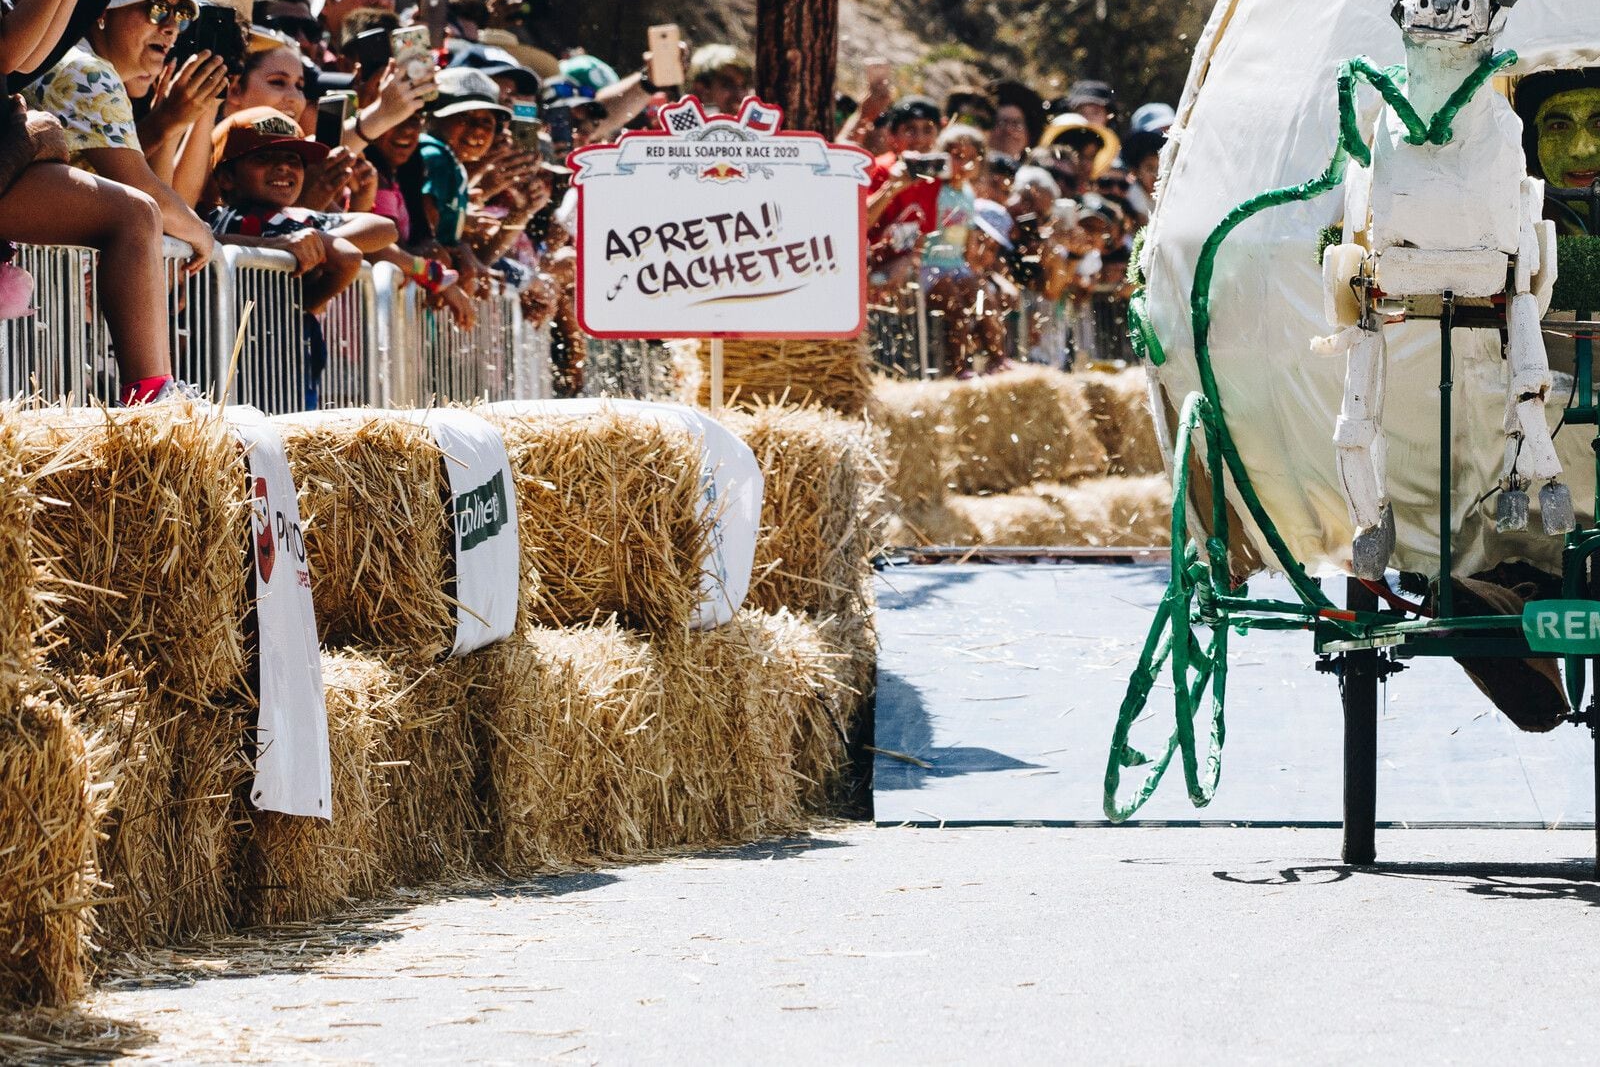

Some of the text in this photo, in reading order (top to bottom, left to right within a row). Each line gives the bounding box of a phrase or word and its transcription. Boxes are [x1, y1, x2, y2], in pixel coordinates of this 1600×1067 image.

[646, 146, 799, 158] RED BULL SOAPBOX RACE 2020
[605, 202, 774, 261] APRETA!
[637, 234, 836, 295] CACHETE!!
